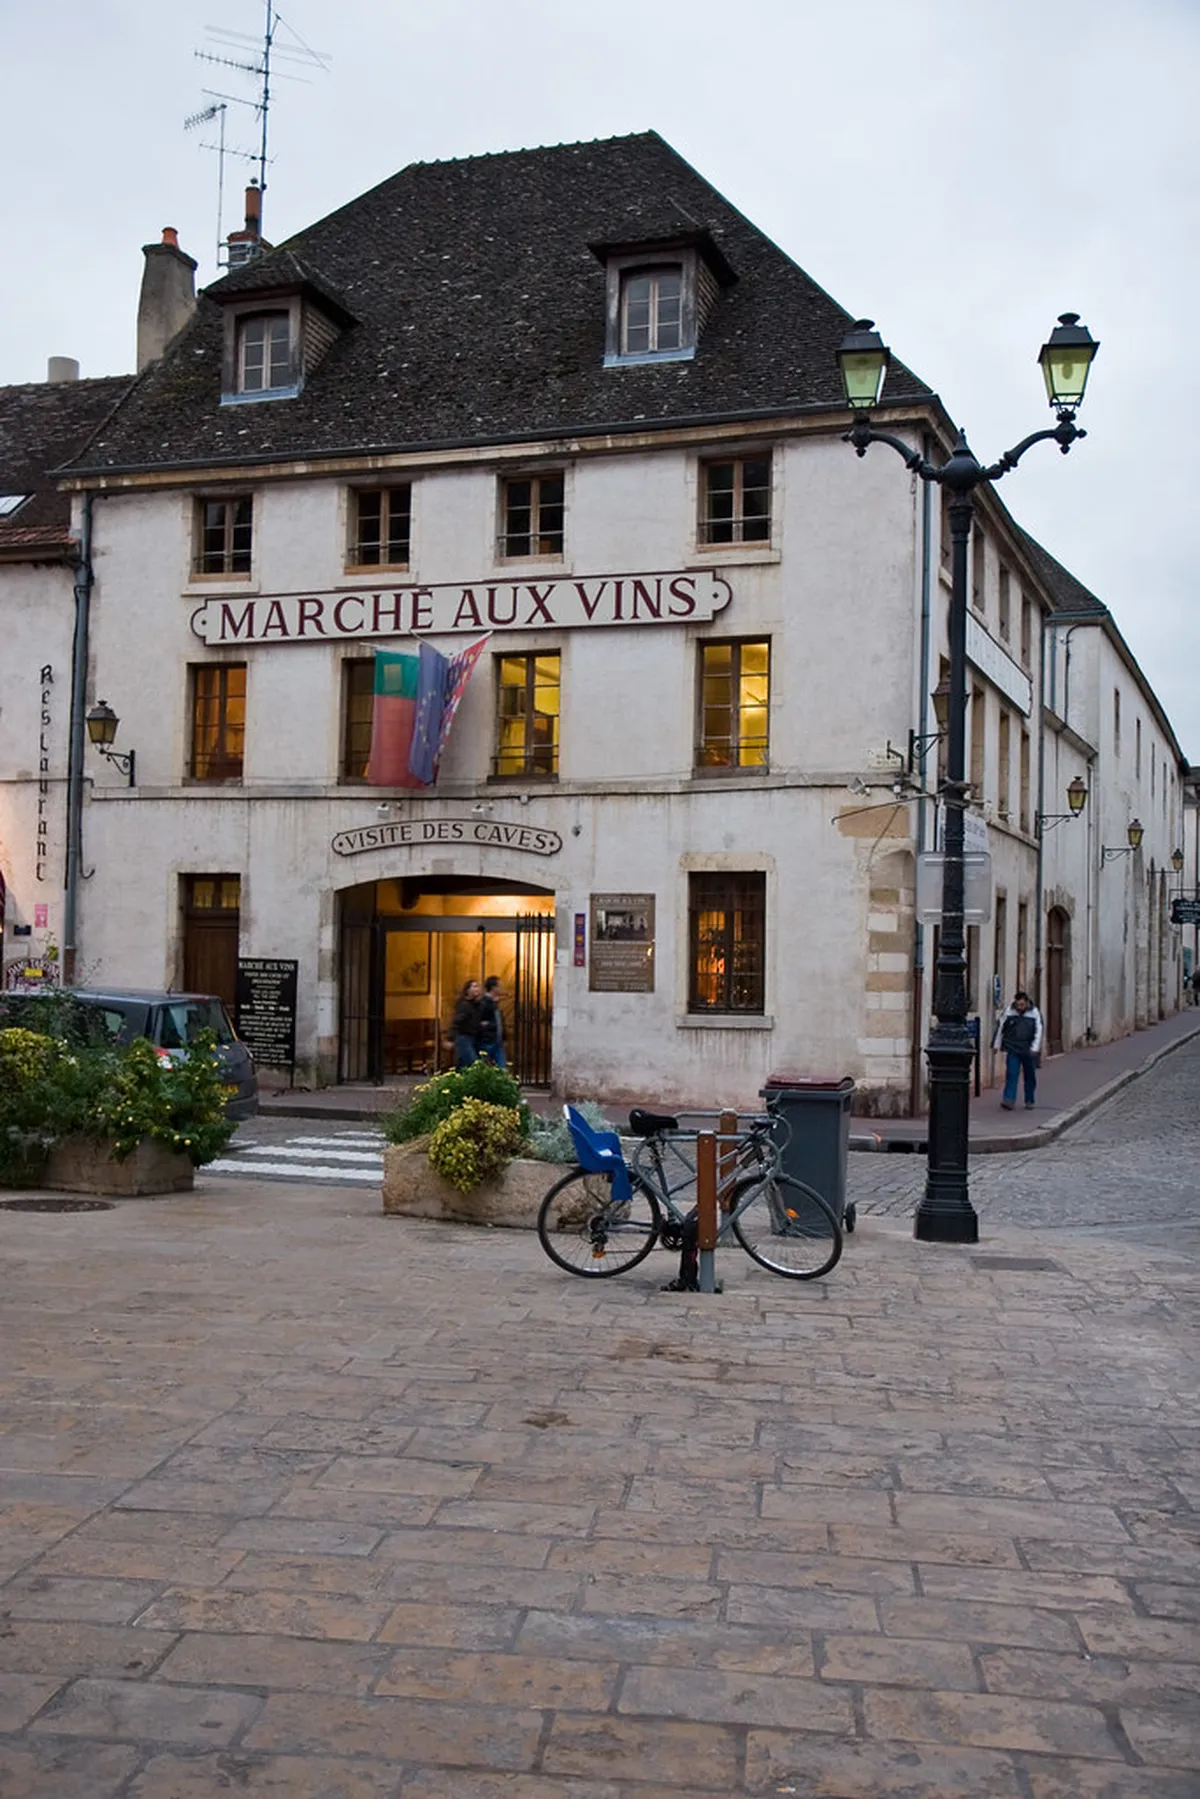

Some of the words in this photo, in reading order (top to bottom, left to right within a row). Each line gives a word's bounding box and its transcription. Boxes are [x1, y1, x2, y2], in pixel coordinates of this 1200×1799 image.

[219, 587, 434, 640] MARCHÉ
[451, 584, 557, 628] AUX
[573, 576, 697, 621] VINS
[344, 824, 413, 850] VISITE
[422, 823, 464, 840] DES
[473, 823, 548, 850] CAVES
